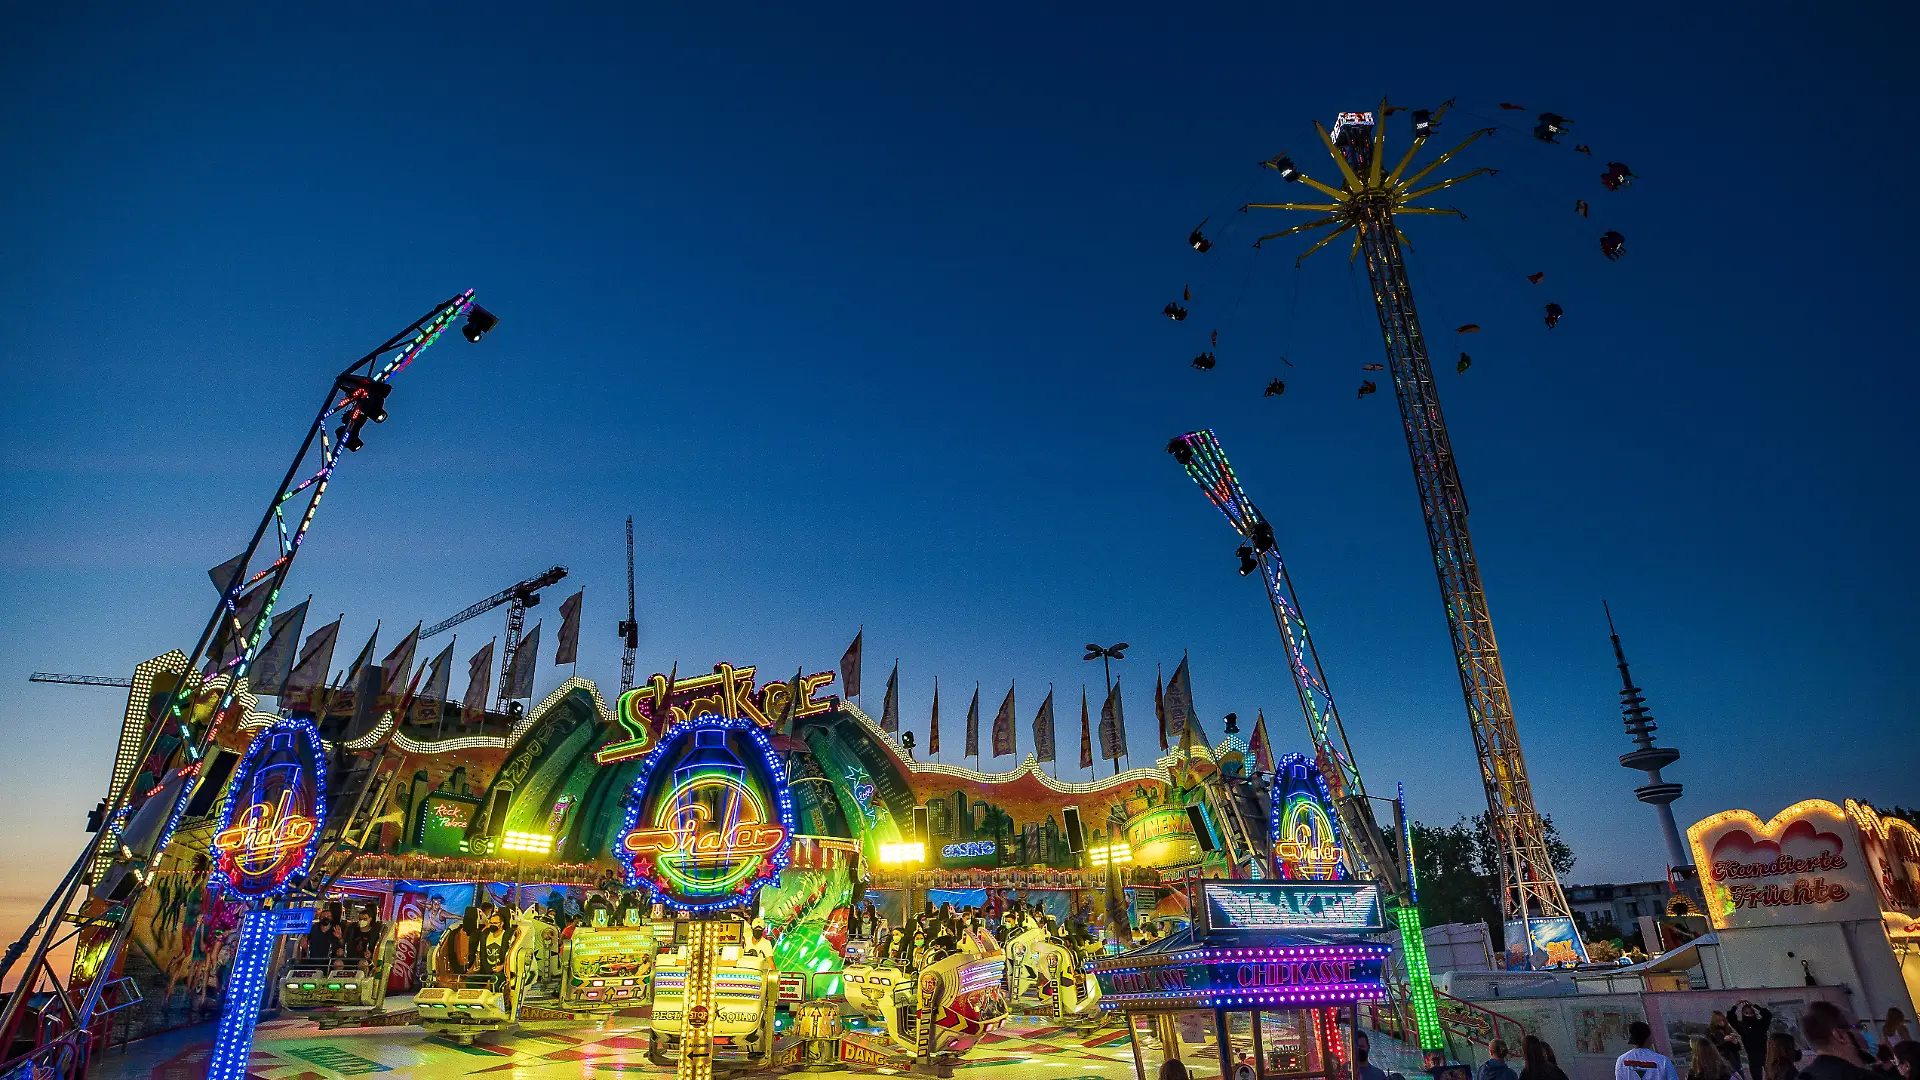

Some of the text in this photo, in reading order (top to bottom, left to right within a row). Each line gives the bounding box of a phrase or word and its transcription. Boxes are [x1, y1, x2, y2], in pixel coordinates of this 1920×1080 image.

[434, 803, 461, 816] Rock
[625, 790, 784, 856] Shaker
[1128, 814, 1195, 845] CINEMA
[1279, 816, 1343, 864] Shaker
[941, 840, 996, 858] CASINO
[1710, 850, 1848, 882] Kandierte
[1731, 876, 1850, 909] Früchte
[1228, 890, 1366, 924] SHAKER
[1112, 968, 1192, 995] CHIPKASSE
[1237, 961, 1357, 988] CHIPKASSE
[689, 1010, 708, 1020] STOP
[719, 1012, 758, 1023] SQUAD
[844, 1043, 906, 1069] DANG
